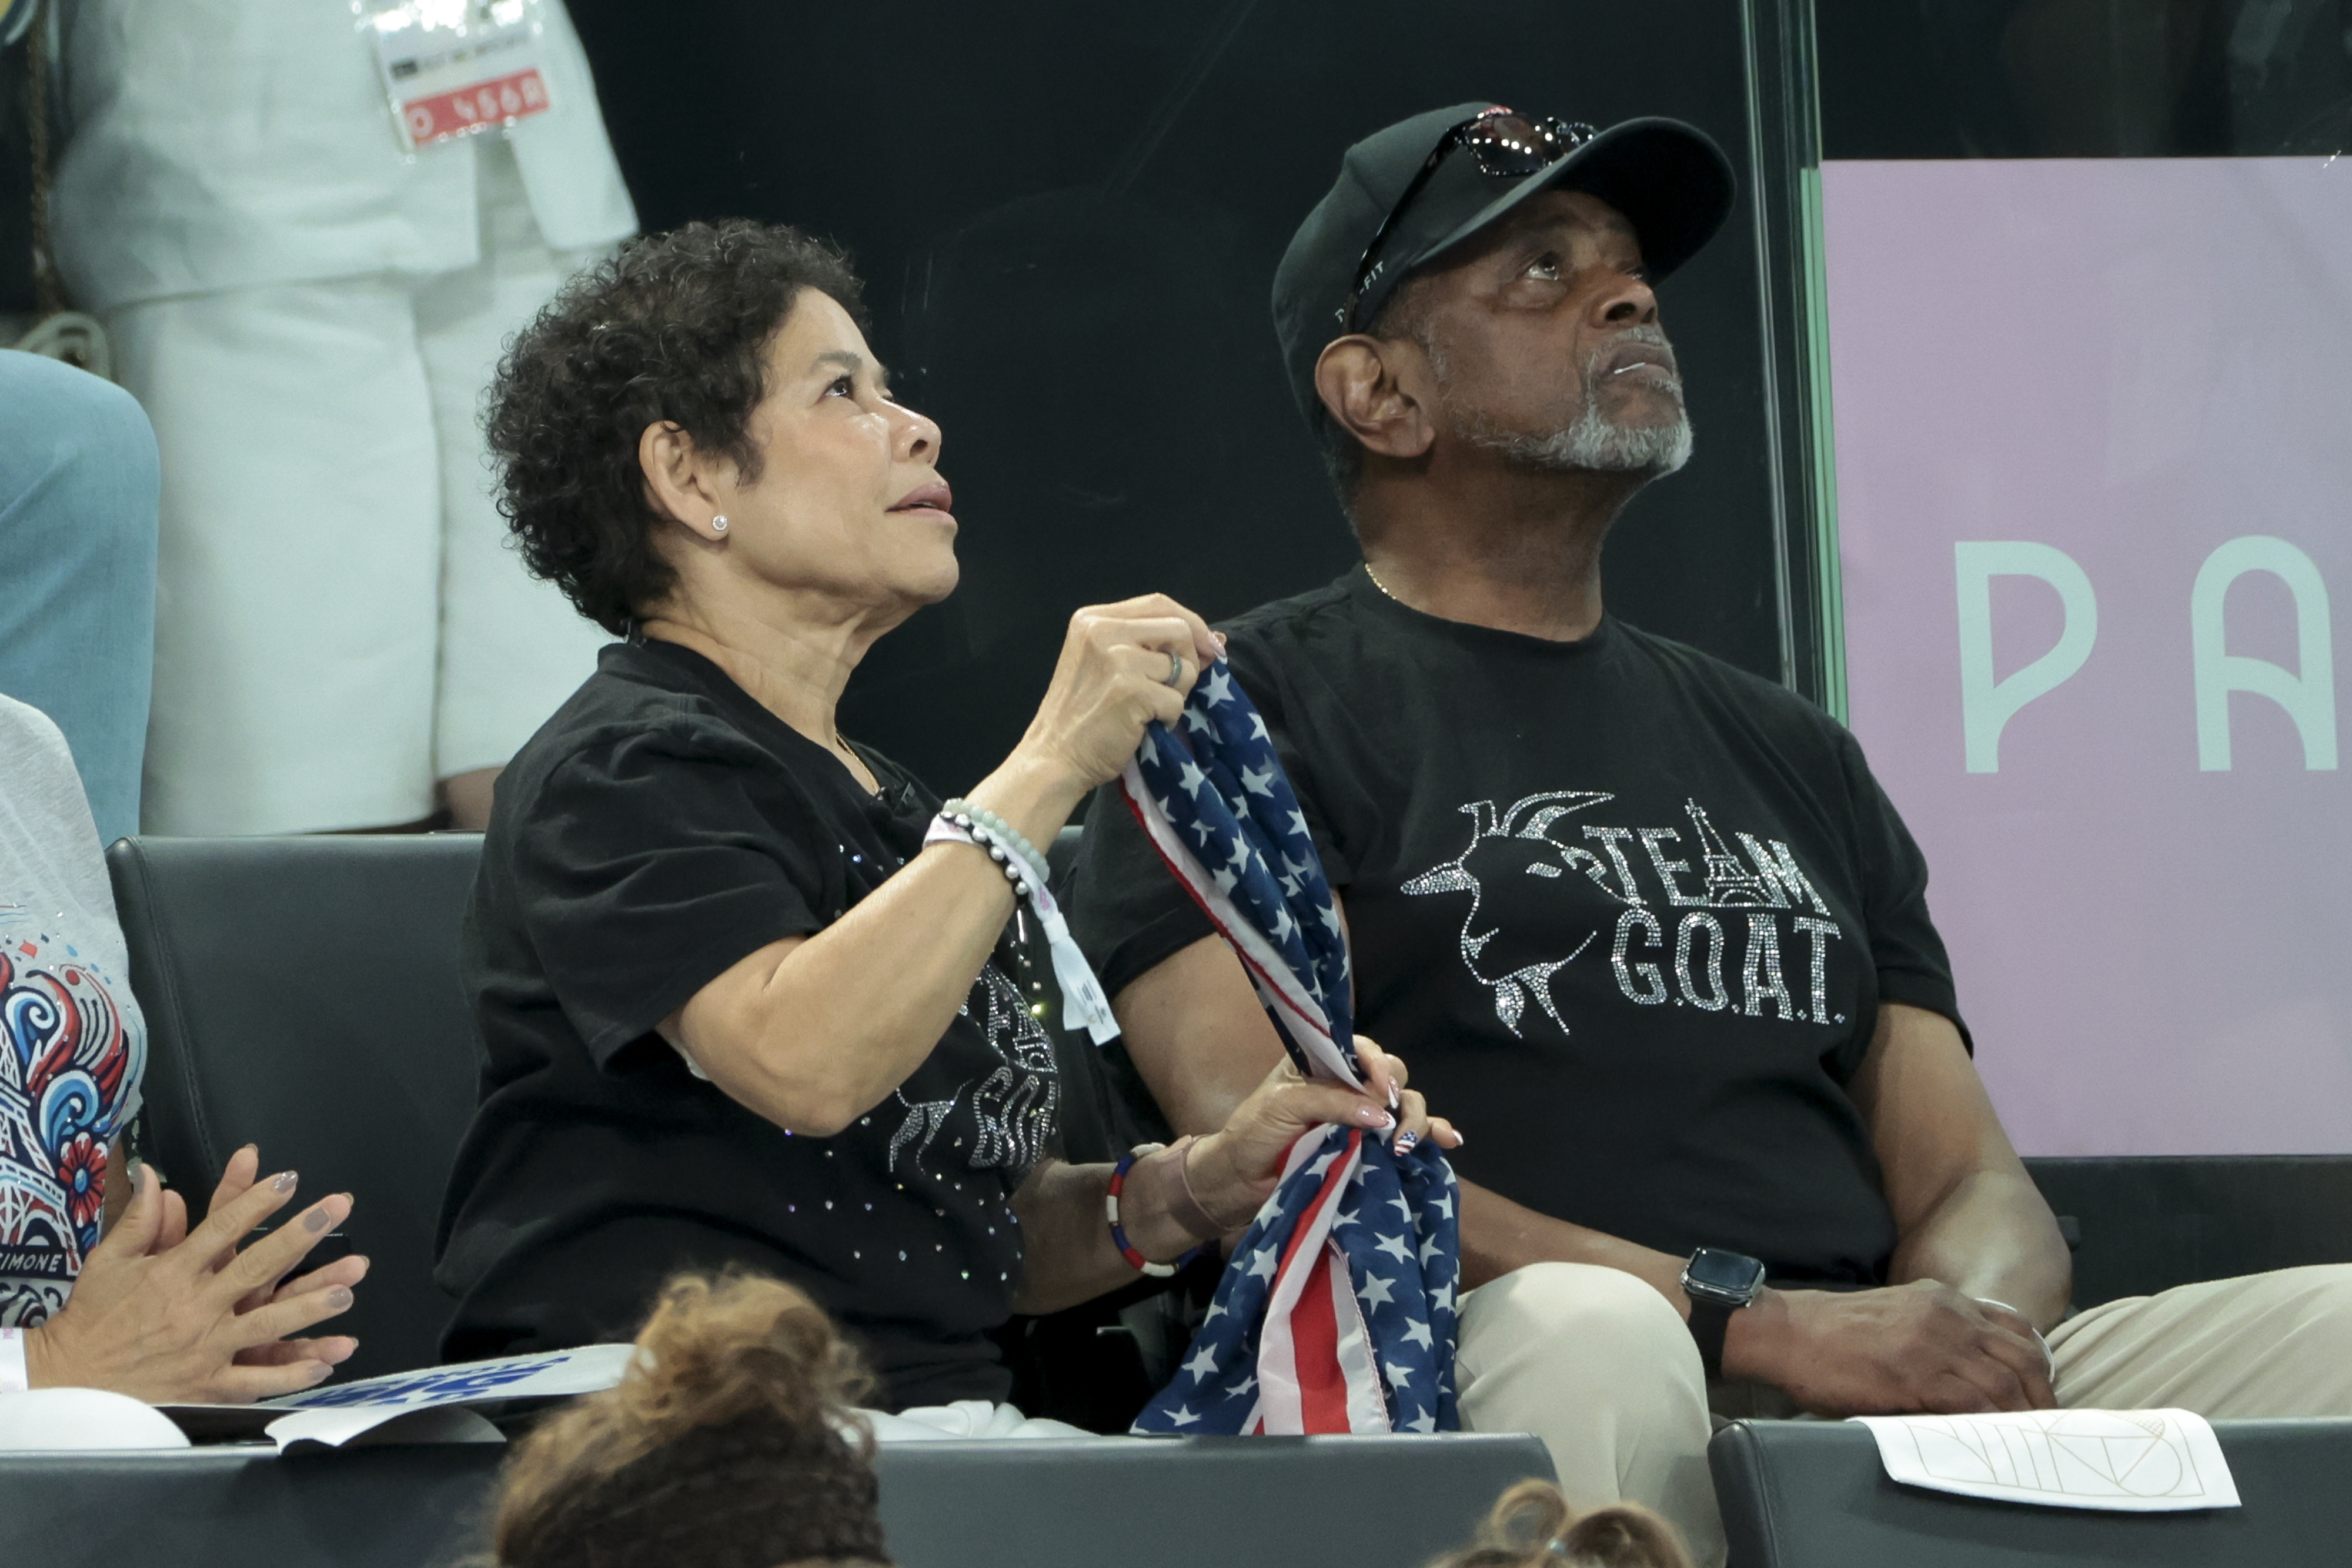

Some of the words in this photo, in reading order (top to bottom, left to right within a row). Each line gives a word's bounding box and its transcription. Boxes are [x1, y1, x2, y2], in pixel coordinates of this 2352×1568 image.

[1955, 534, 2339, 774] PA
[1582, 798, 1830, 916] TEAM
[1611, 908, 1845, 1024] G.O.A.T.
